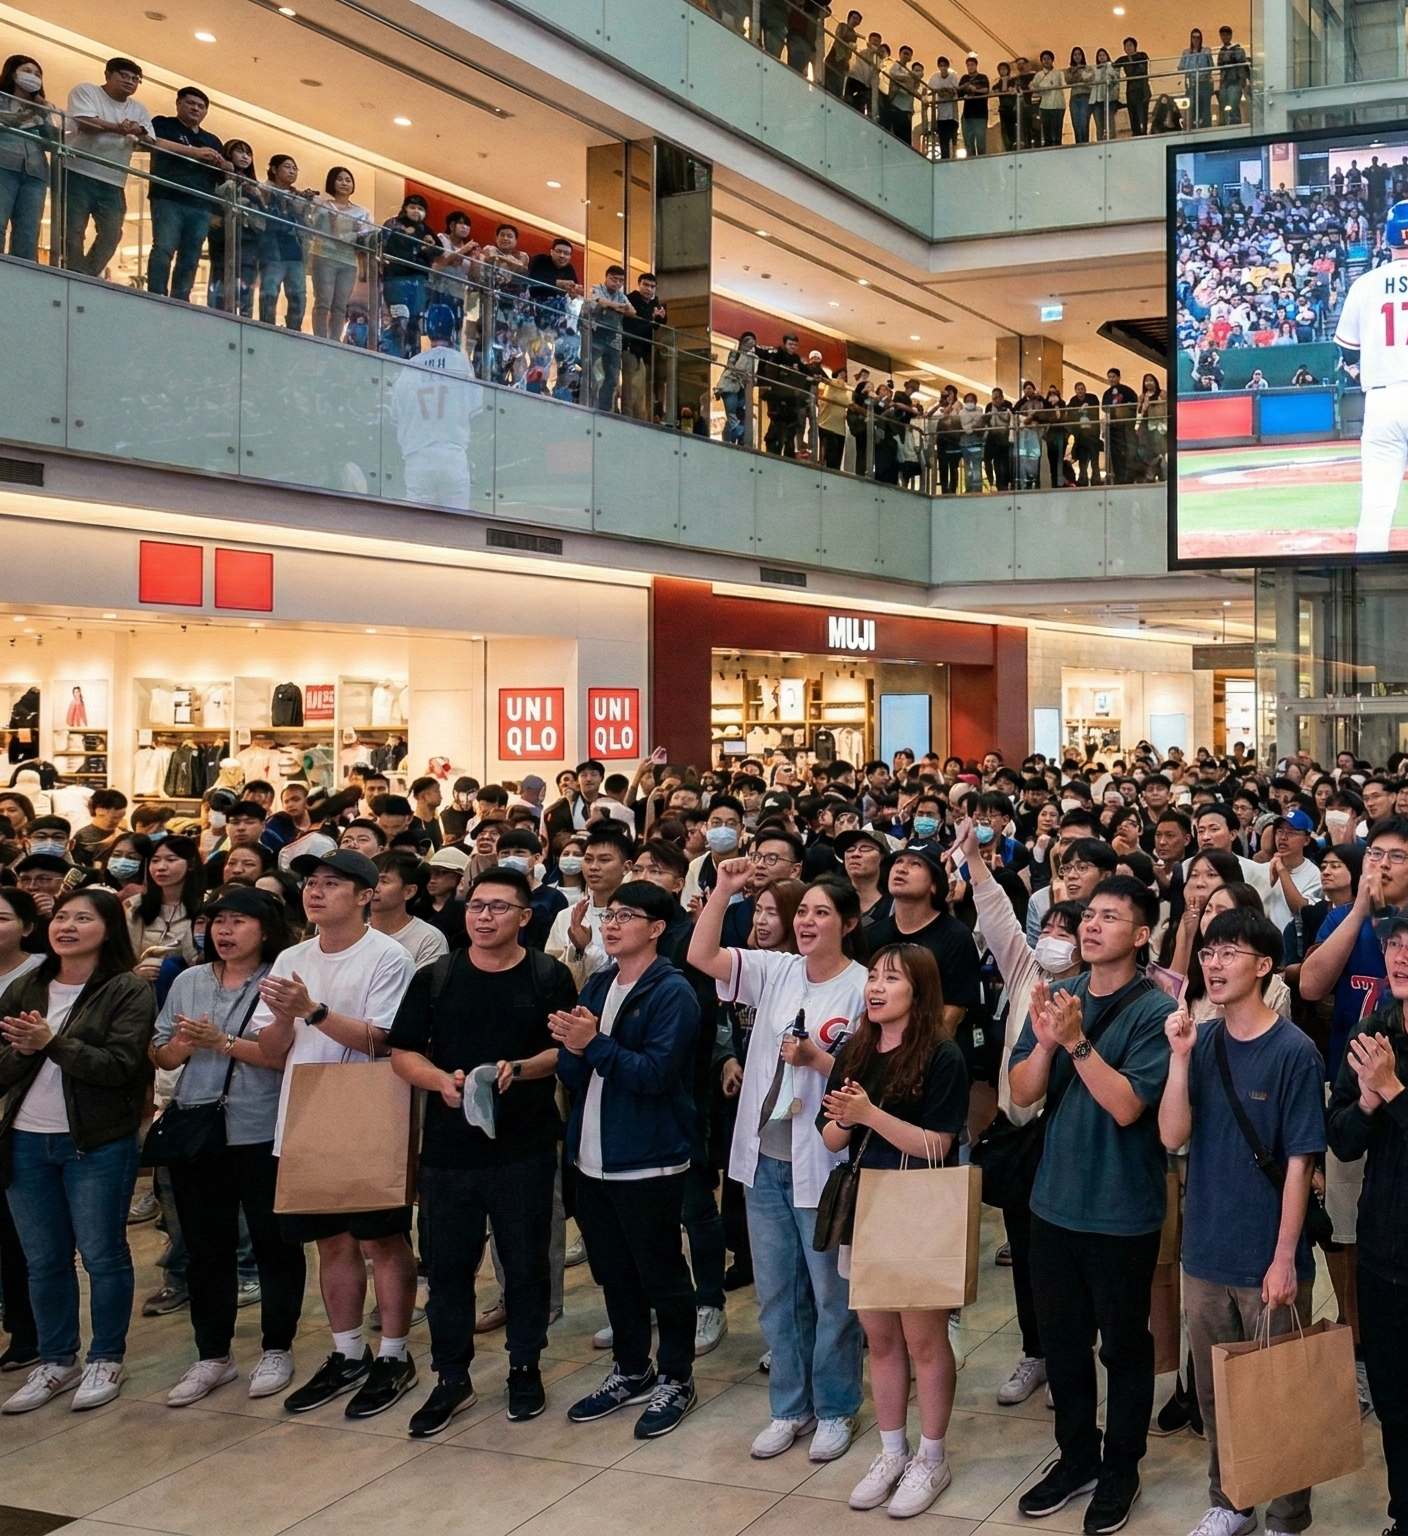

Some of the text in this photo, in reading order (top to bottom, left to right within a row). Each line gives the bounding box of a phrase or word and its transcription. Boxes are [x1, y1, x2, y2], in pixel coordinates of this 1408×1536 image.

[828, 615, 876, 651] MUJI
[506, 696, 552, 722] UNI
[594, 697, 630, 721] UNI
[506, 726, 557, 756] QLO
[594, 726, 633, 755] QLO
